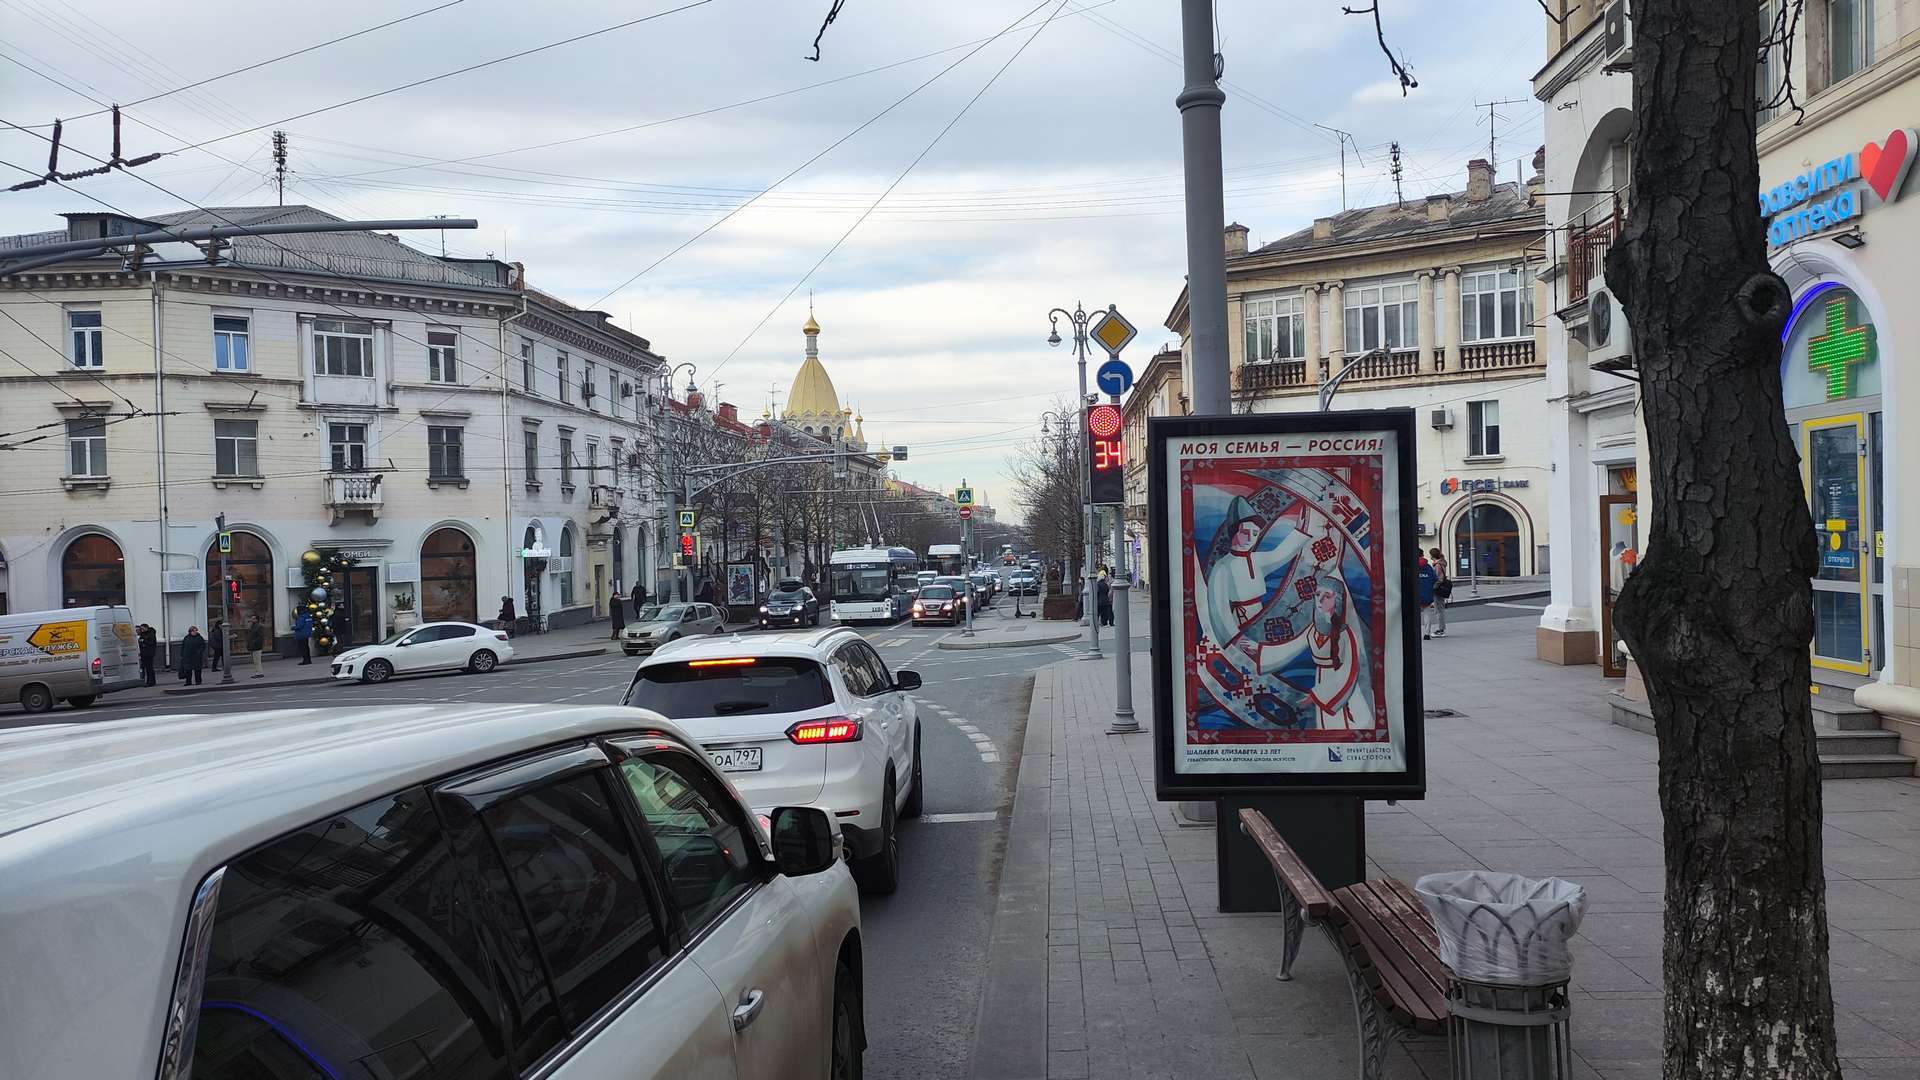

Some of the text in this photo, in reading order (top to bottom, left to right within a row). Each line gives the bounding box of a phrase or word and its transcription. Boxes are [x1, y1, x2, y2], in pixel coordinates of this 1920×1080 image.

[1771, 191, 1854, 246] аптека
[1095, 440, 1122, 468] 34
[1180, 442, 1218, 455] МОЯ
[1225, 440, 1280, 454] СЕМЬЯ
[1308, 438, 1384, 452] РОССИЯ!
[37, 642, 80, 654] СЛУЖБА
[707, 752, 733, 767] ОА
[735, 750, 757, 762] 797
